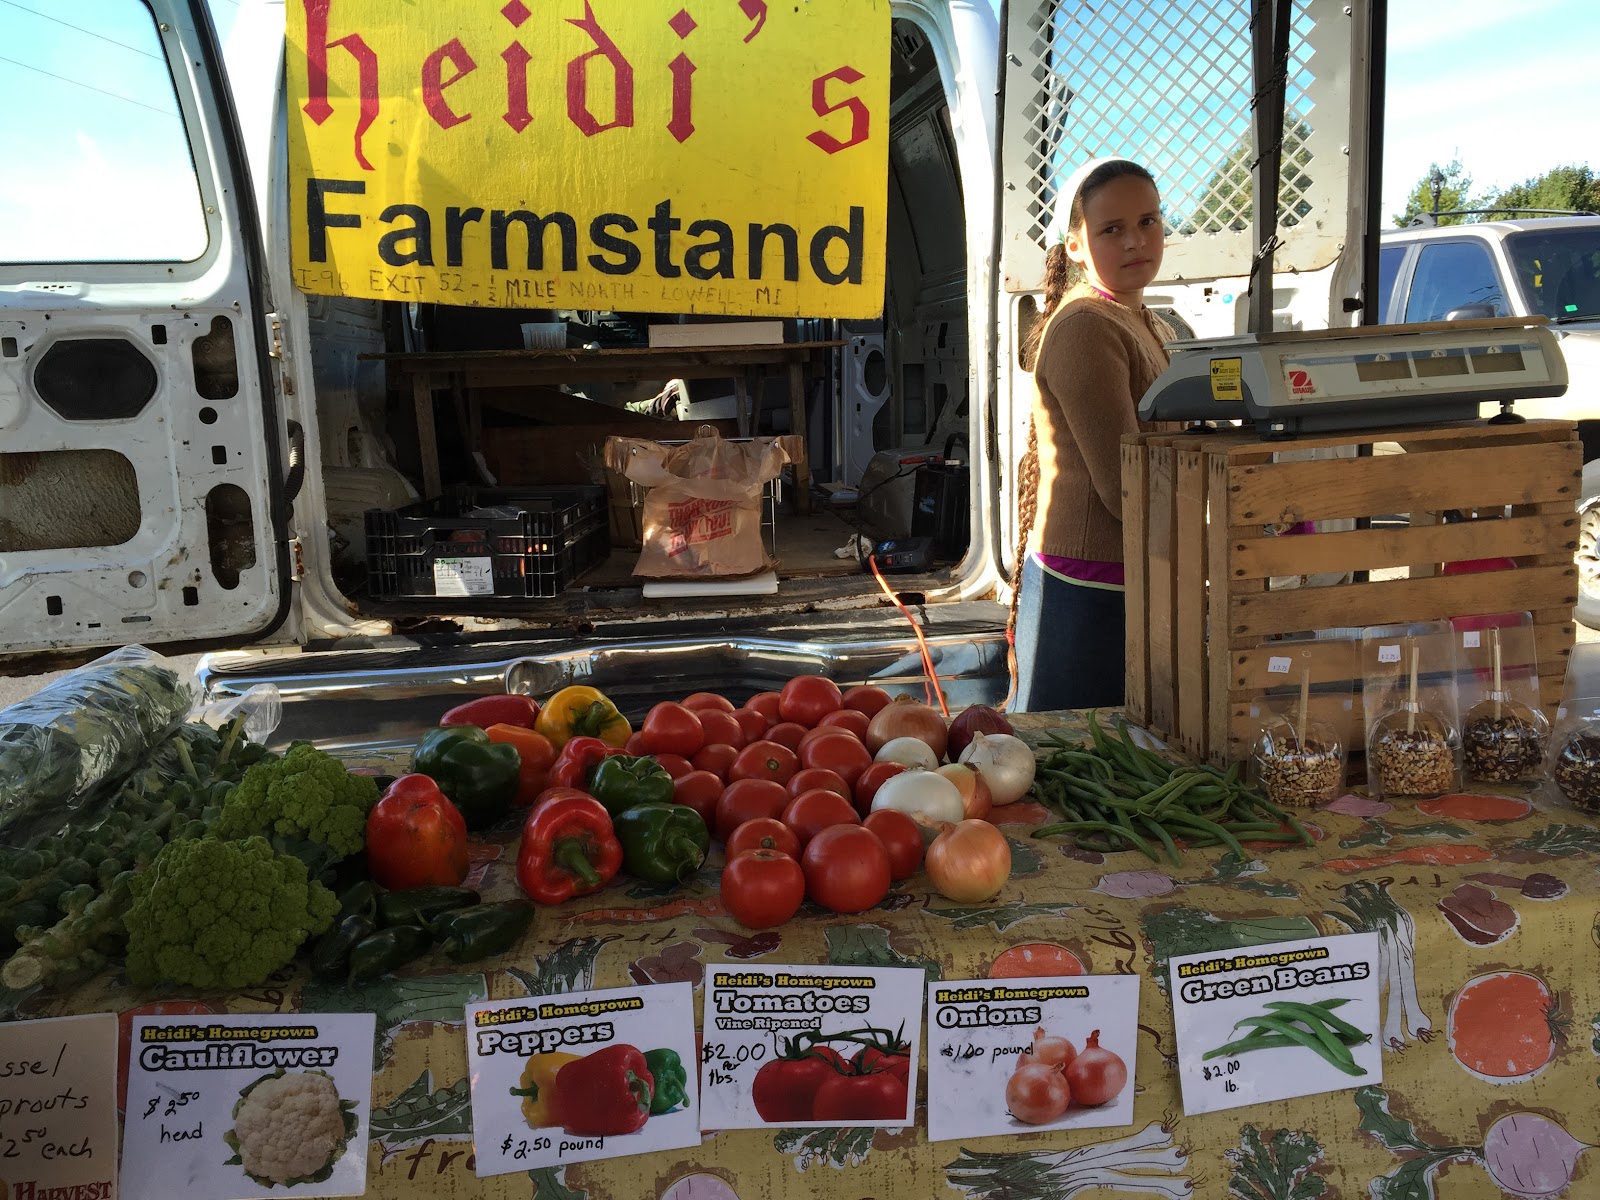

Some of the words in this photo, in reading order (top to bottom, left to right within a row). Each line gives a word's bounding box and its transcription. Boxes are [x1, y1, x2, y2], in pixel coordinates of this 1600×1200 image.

[306, 178, 865, 286] Farmstand
[370, 270, 426, 295] EXIT
[506, 279, 557, 299] MILE
[1179, 958, 1233, 976] Heidi's
[1234, 948, 1328, 970] Homegrown
[714, 973, 773, 988] Heidi's
[776, 974, 875, 991] Homegrown
[1181, 974, 1273, 1003] Green
[1275, 961, 1369, 991] Beans
[715, 991, 869, 1014] Tomatoes
[936, 988, 993, 1003] Heidi's
[993, 986, 1088, 1002] Homegrown
[475, 1006, 538, 1027] Heidi's
[540, 997, 643, 1019] Homegrown
[715, 1016, 754, 1031] Vine
[754, 1016, 822, 1031] Ripened
[936, 1005, 1042, 1028] Onions
[142, 1026, 206, 1042] Heidi's
[209, 1025, 317, 1042] Homegrown
[477, 1022, 614, 1057] Peppers
[140, 1045, 338, 1071] Cauliflower
[702, 1041, 766, 1064] $2.00
[992, 1042, 1034, 1063] pound
[160, 1121, 203, 1144] head
[42, 1137, 93, 1160] each
[500, 1133, 552, 1160] $2.50
[559, 1135, 604, 1158] pound
